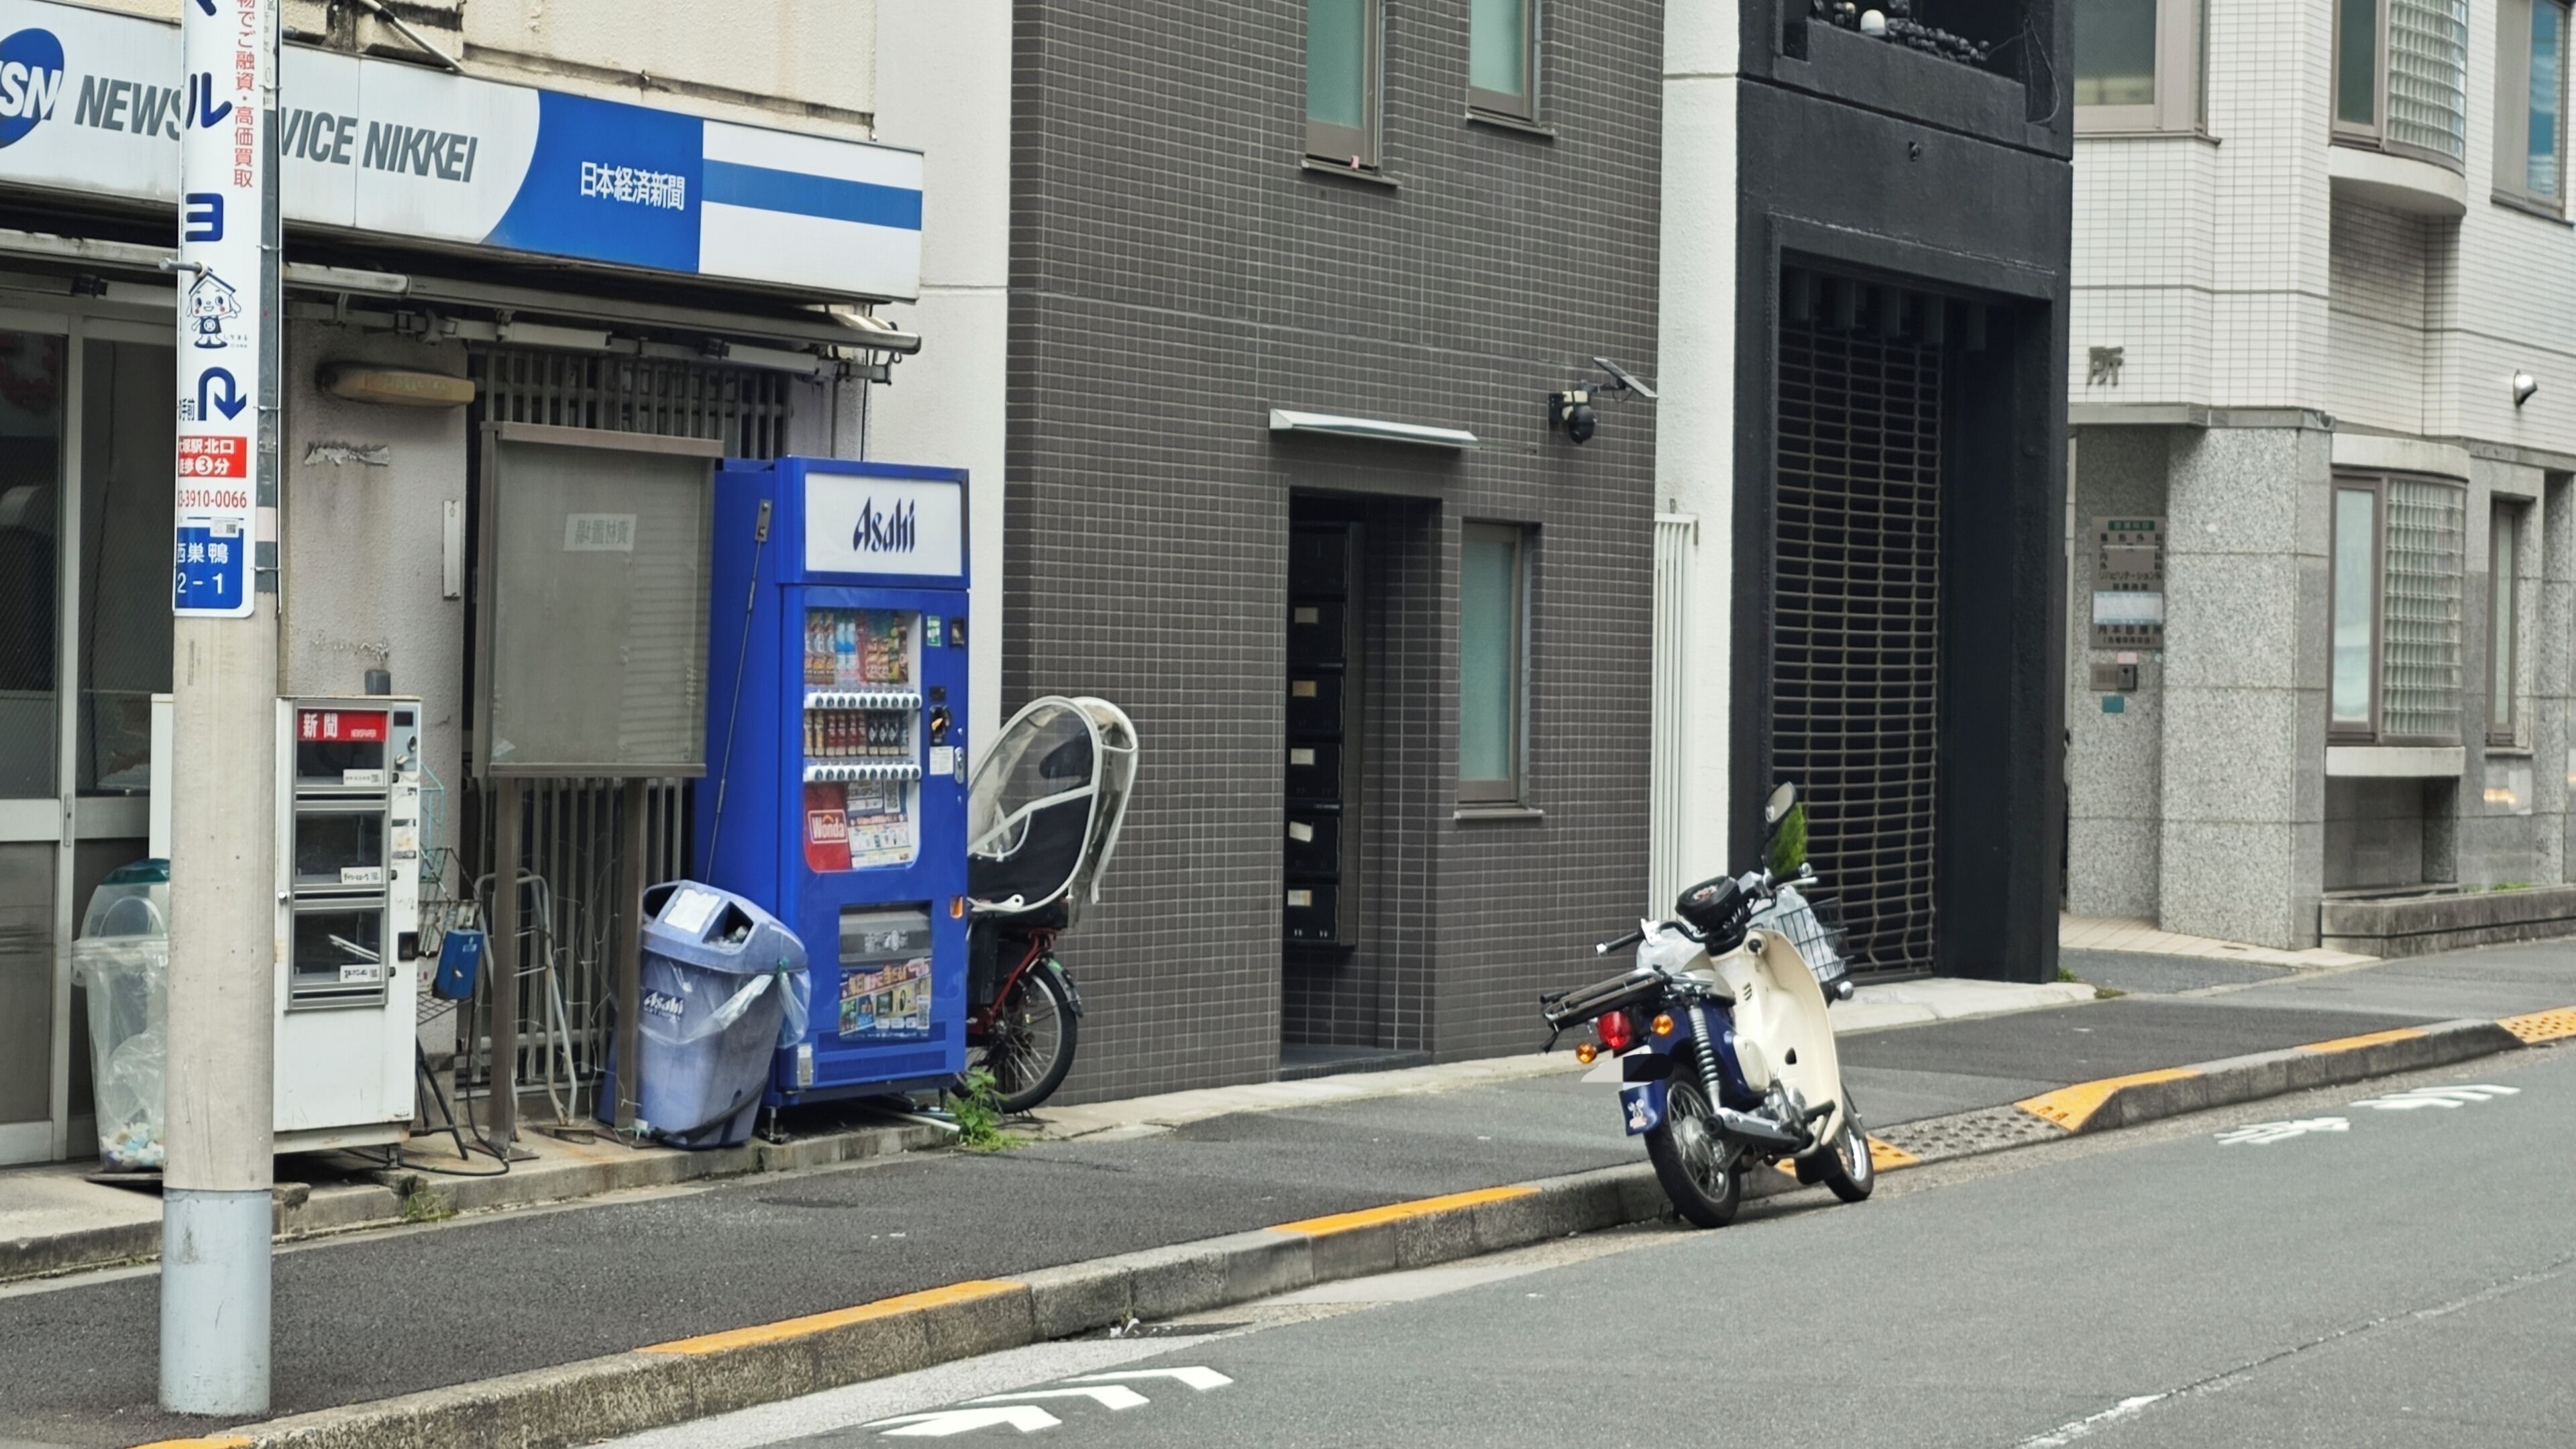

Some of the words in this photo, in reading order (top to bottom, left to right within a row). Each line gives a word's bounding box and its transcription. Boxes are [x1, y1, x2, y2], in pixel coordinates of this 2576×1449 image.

[0, 60, 62, 121] SN
[362, 121, 478, 183] NIKKEI
[579, 162, 685, 211] 日本経済新聞
[2087, 345, 2123, 386] 所
[853, 496, 916, 553] Asahi
[177, 542, 229, 564] 西巣鴨
[303, 713, 338, 739] 新聞
[812, 815, 845, 840] Wonda
[643, 991, 684, 1015] Asahi
